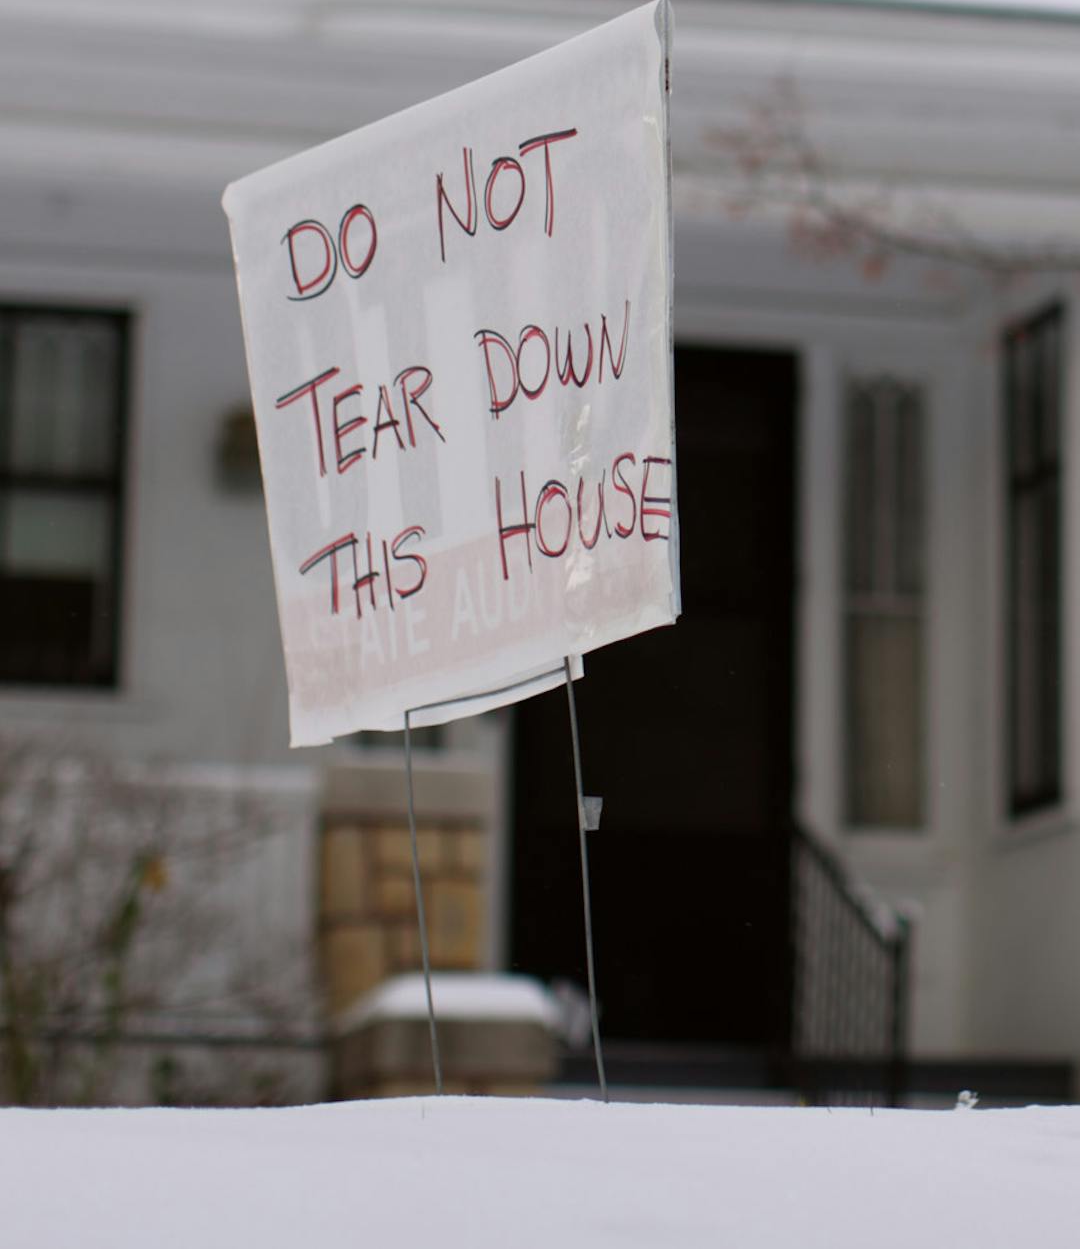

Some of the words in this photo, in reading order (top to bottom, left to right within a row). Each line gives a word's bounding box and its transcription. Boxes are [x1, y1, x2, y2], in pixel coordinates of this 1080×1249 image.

[280, 203, 378, 301] DO
[436, 128, 578, 262] NOT
[275, 365, 446, 477] TEAR
[474, 299, 631, 419] DOWN
[299, 525, 428, 620] THIS
[495, 451, 673, 581] HOUSE
